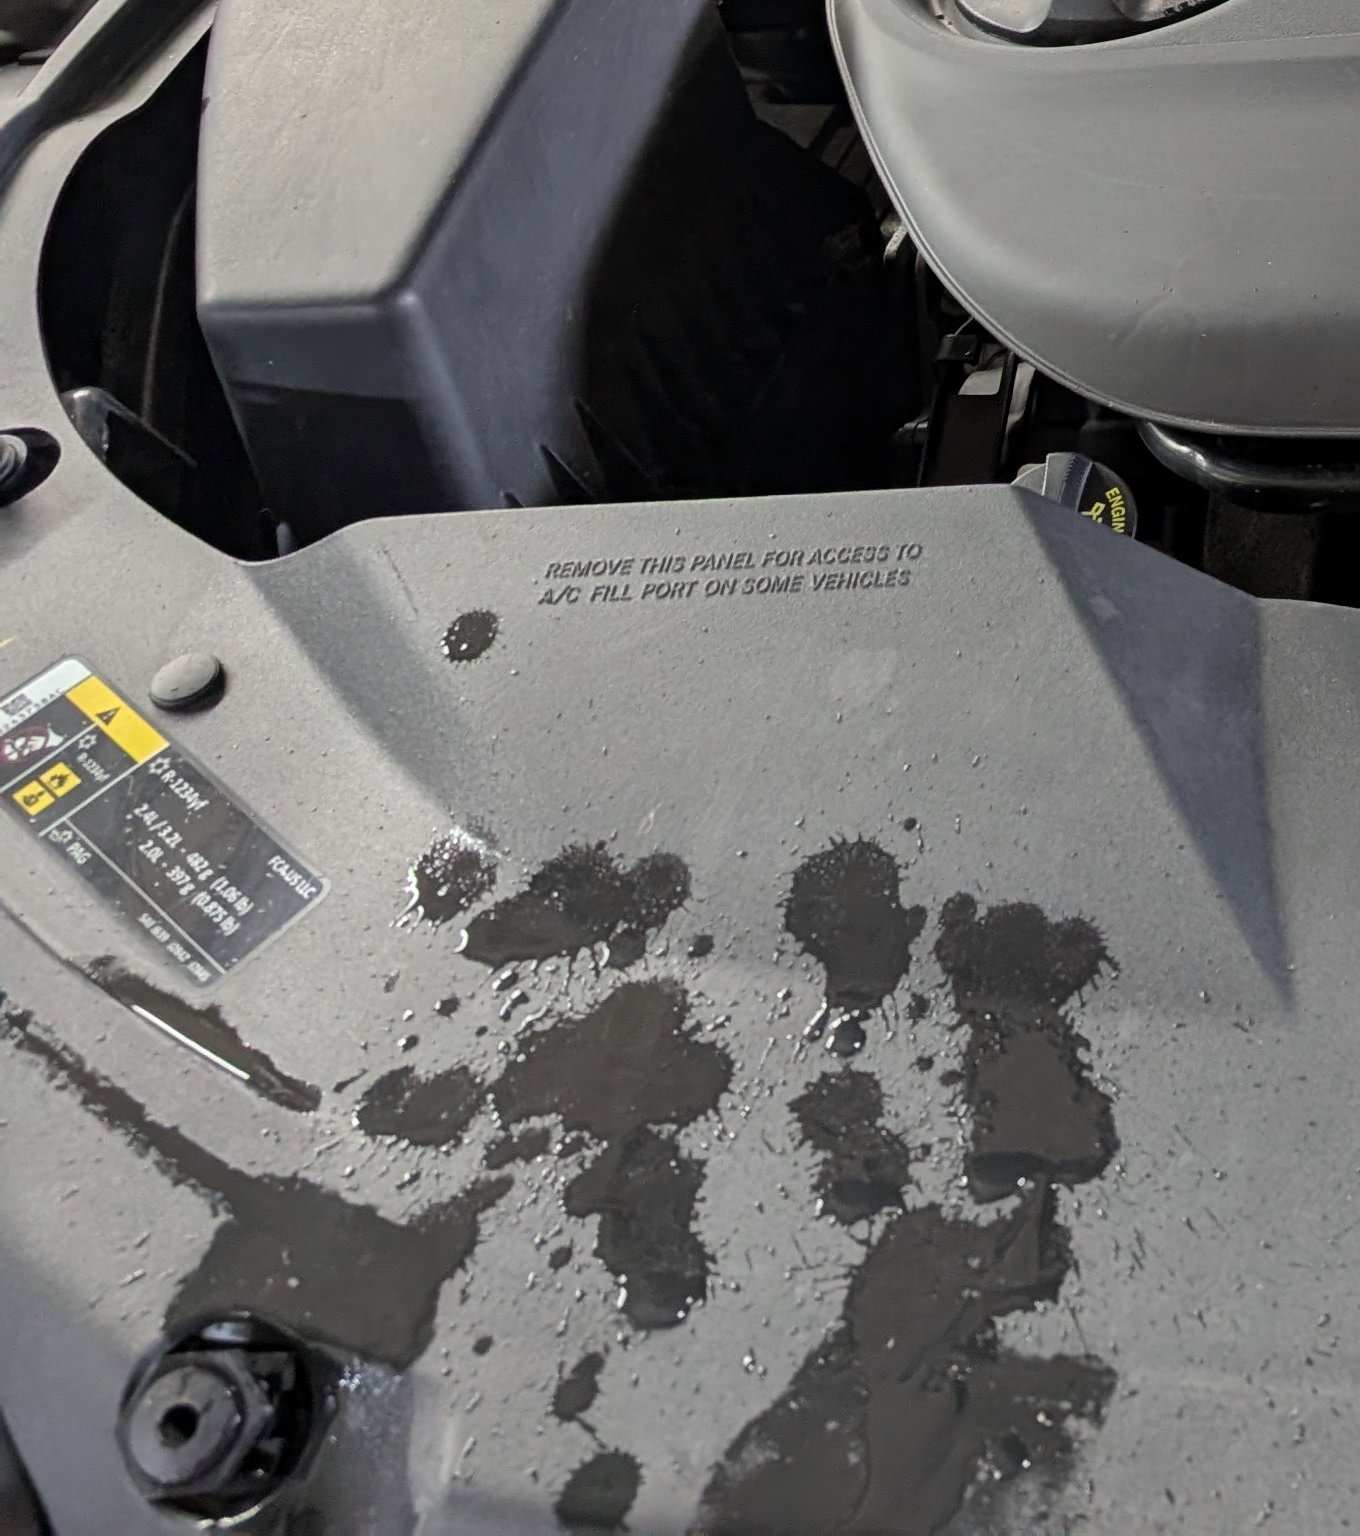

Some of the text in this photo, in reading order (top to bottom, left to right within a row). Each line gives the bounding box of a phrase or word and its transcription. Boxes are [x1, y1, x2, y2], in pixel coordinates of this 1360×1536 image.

[1104, 487, 1126, 533] ENGIN
[544, 543, 923, 579] REMOVE THIS PANEL FOR ACCESS TO
[537, 568, 912, 605] A/C FILL PORT ON SOME VEHICLES
[161, 770, 210, 811] R-1234yf
[66, 842, 92, 865] PAG
[138, 839, 164, 863] 2.0L
[165, 865, 192, 886] 397
[190, 890, 229, 923] (0.875
[209, 876, 242, 904] (1.06
